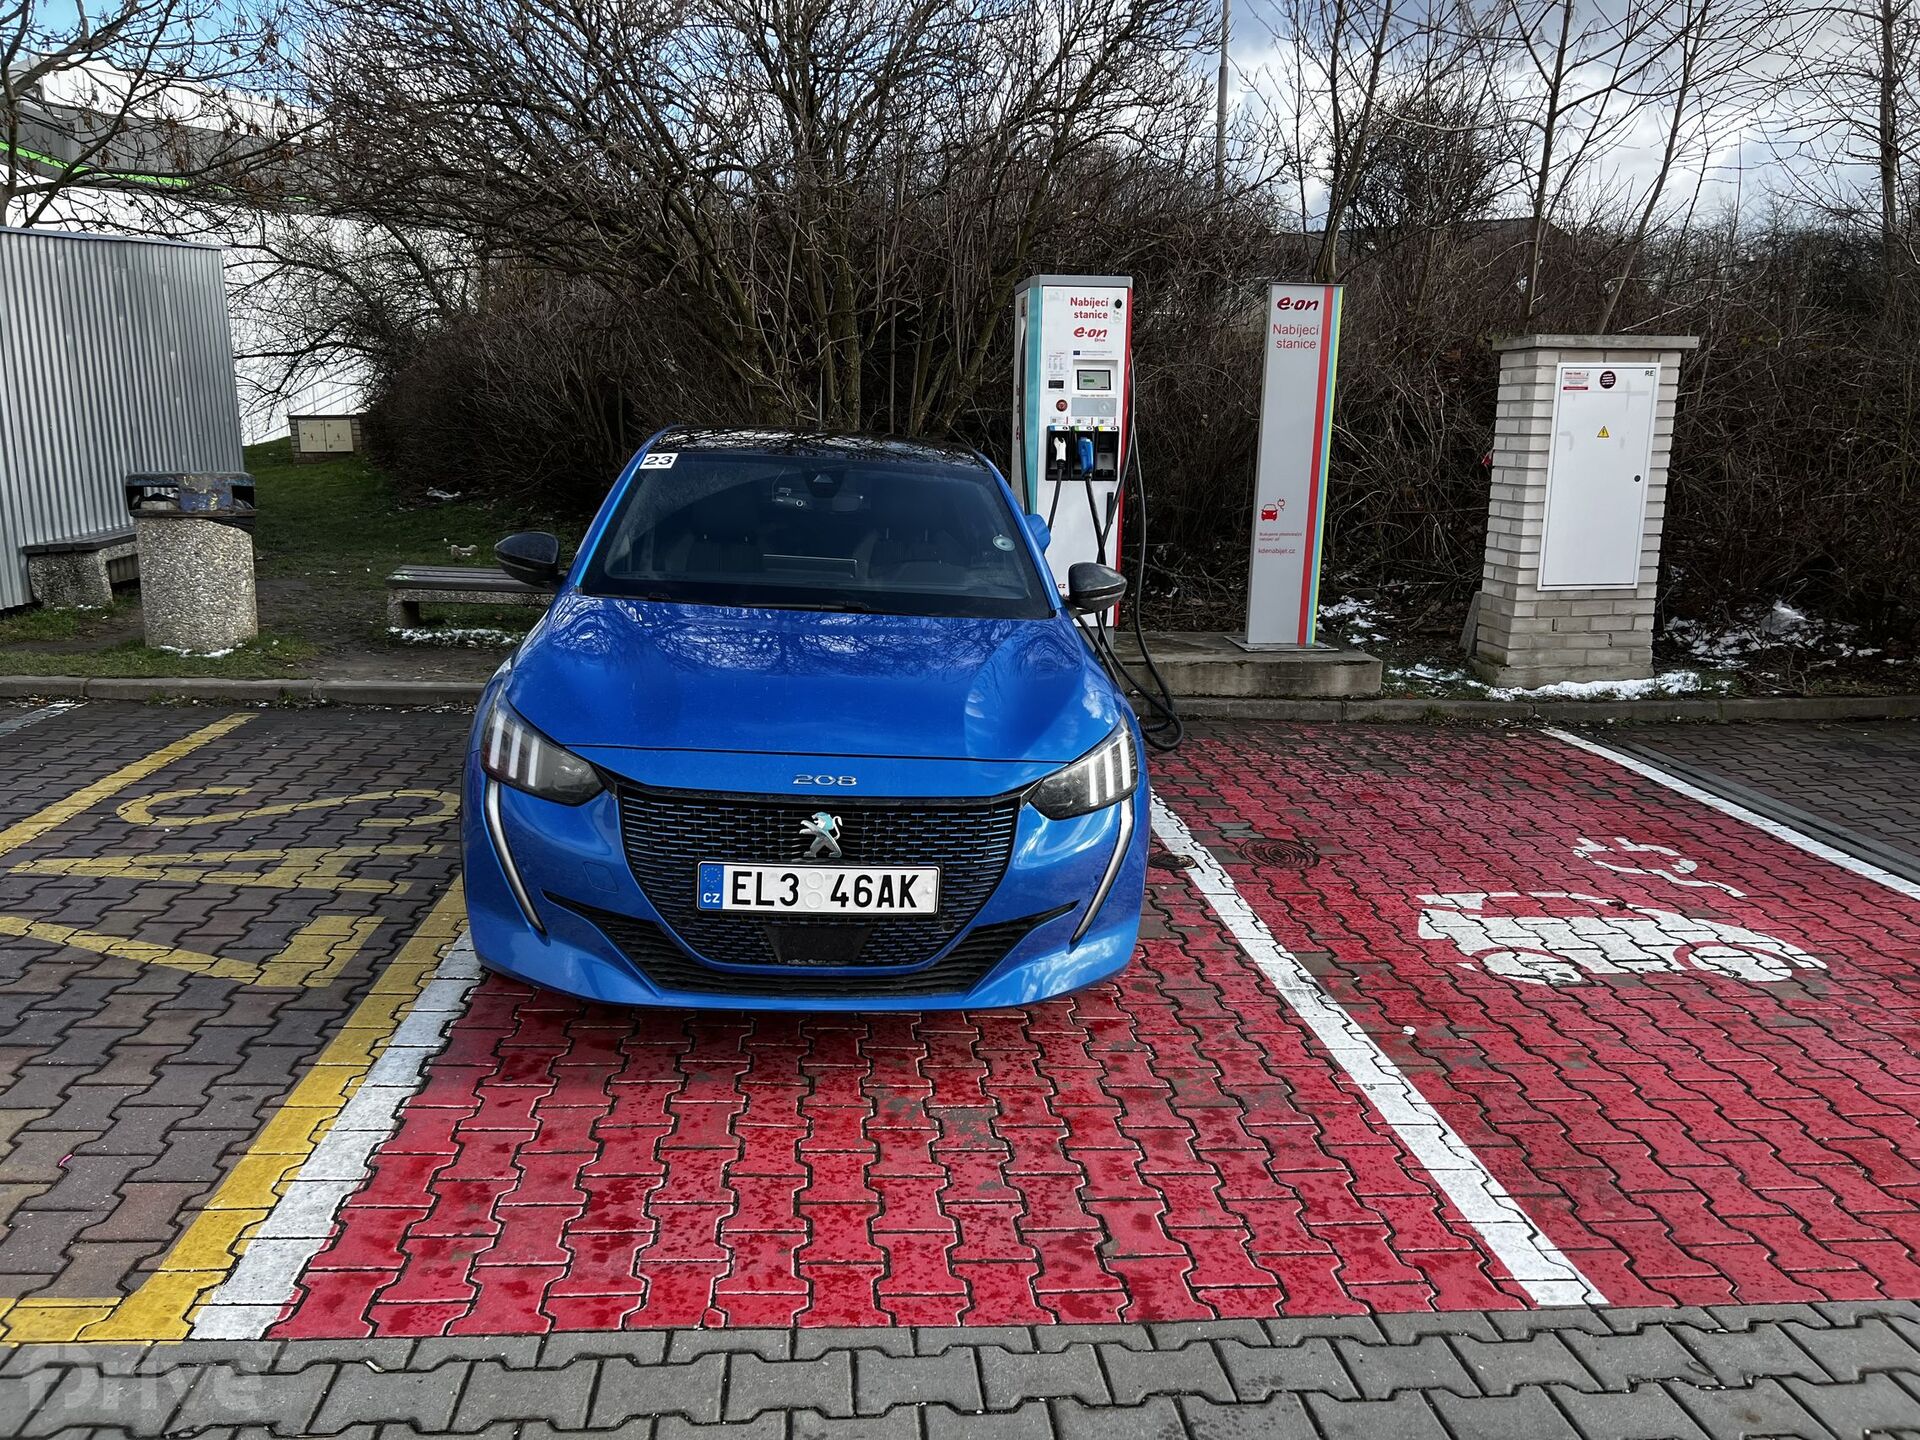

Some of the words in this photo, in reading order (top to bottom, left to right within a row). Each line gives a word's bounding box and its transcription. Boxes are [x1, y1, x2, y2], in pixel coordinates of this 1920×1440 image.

[1073, 310, 1108, 319] stanice
[1276, 338, 1317, 349] stanice
[643, 455, 674, 466] 23
[792, 773, 857, 786] 208
[703, 892, 720, 904] CZ
[731, 870, 800, 907] EL3
[830, 874, 919, 909] 46AK
